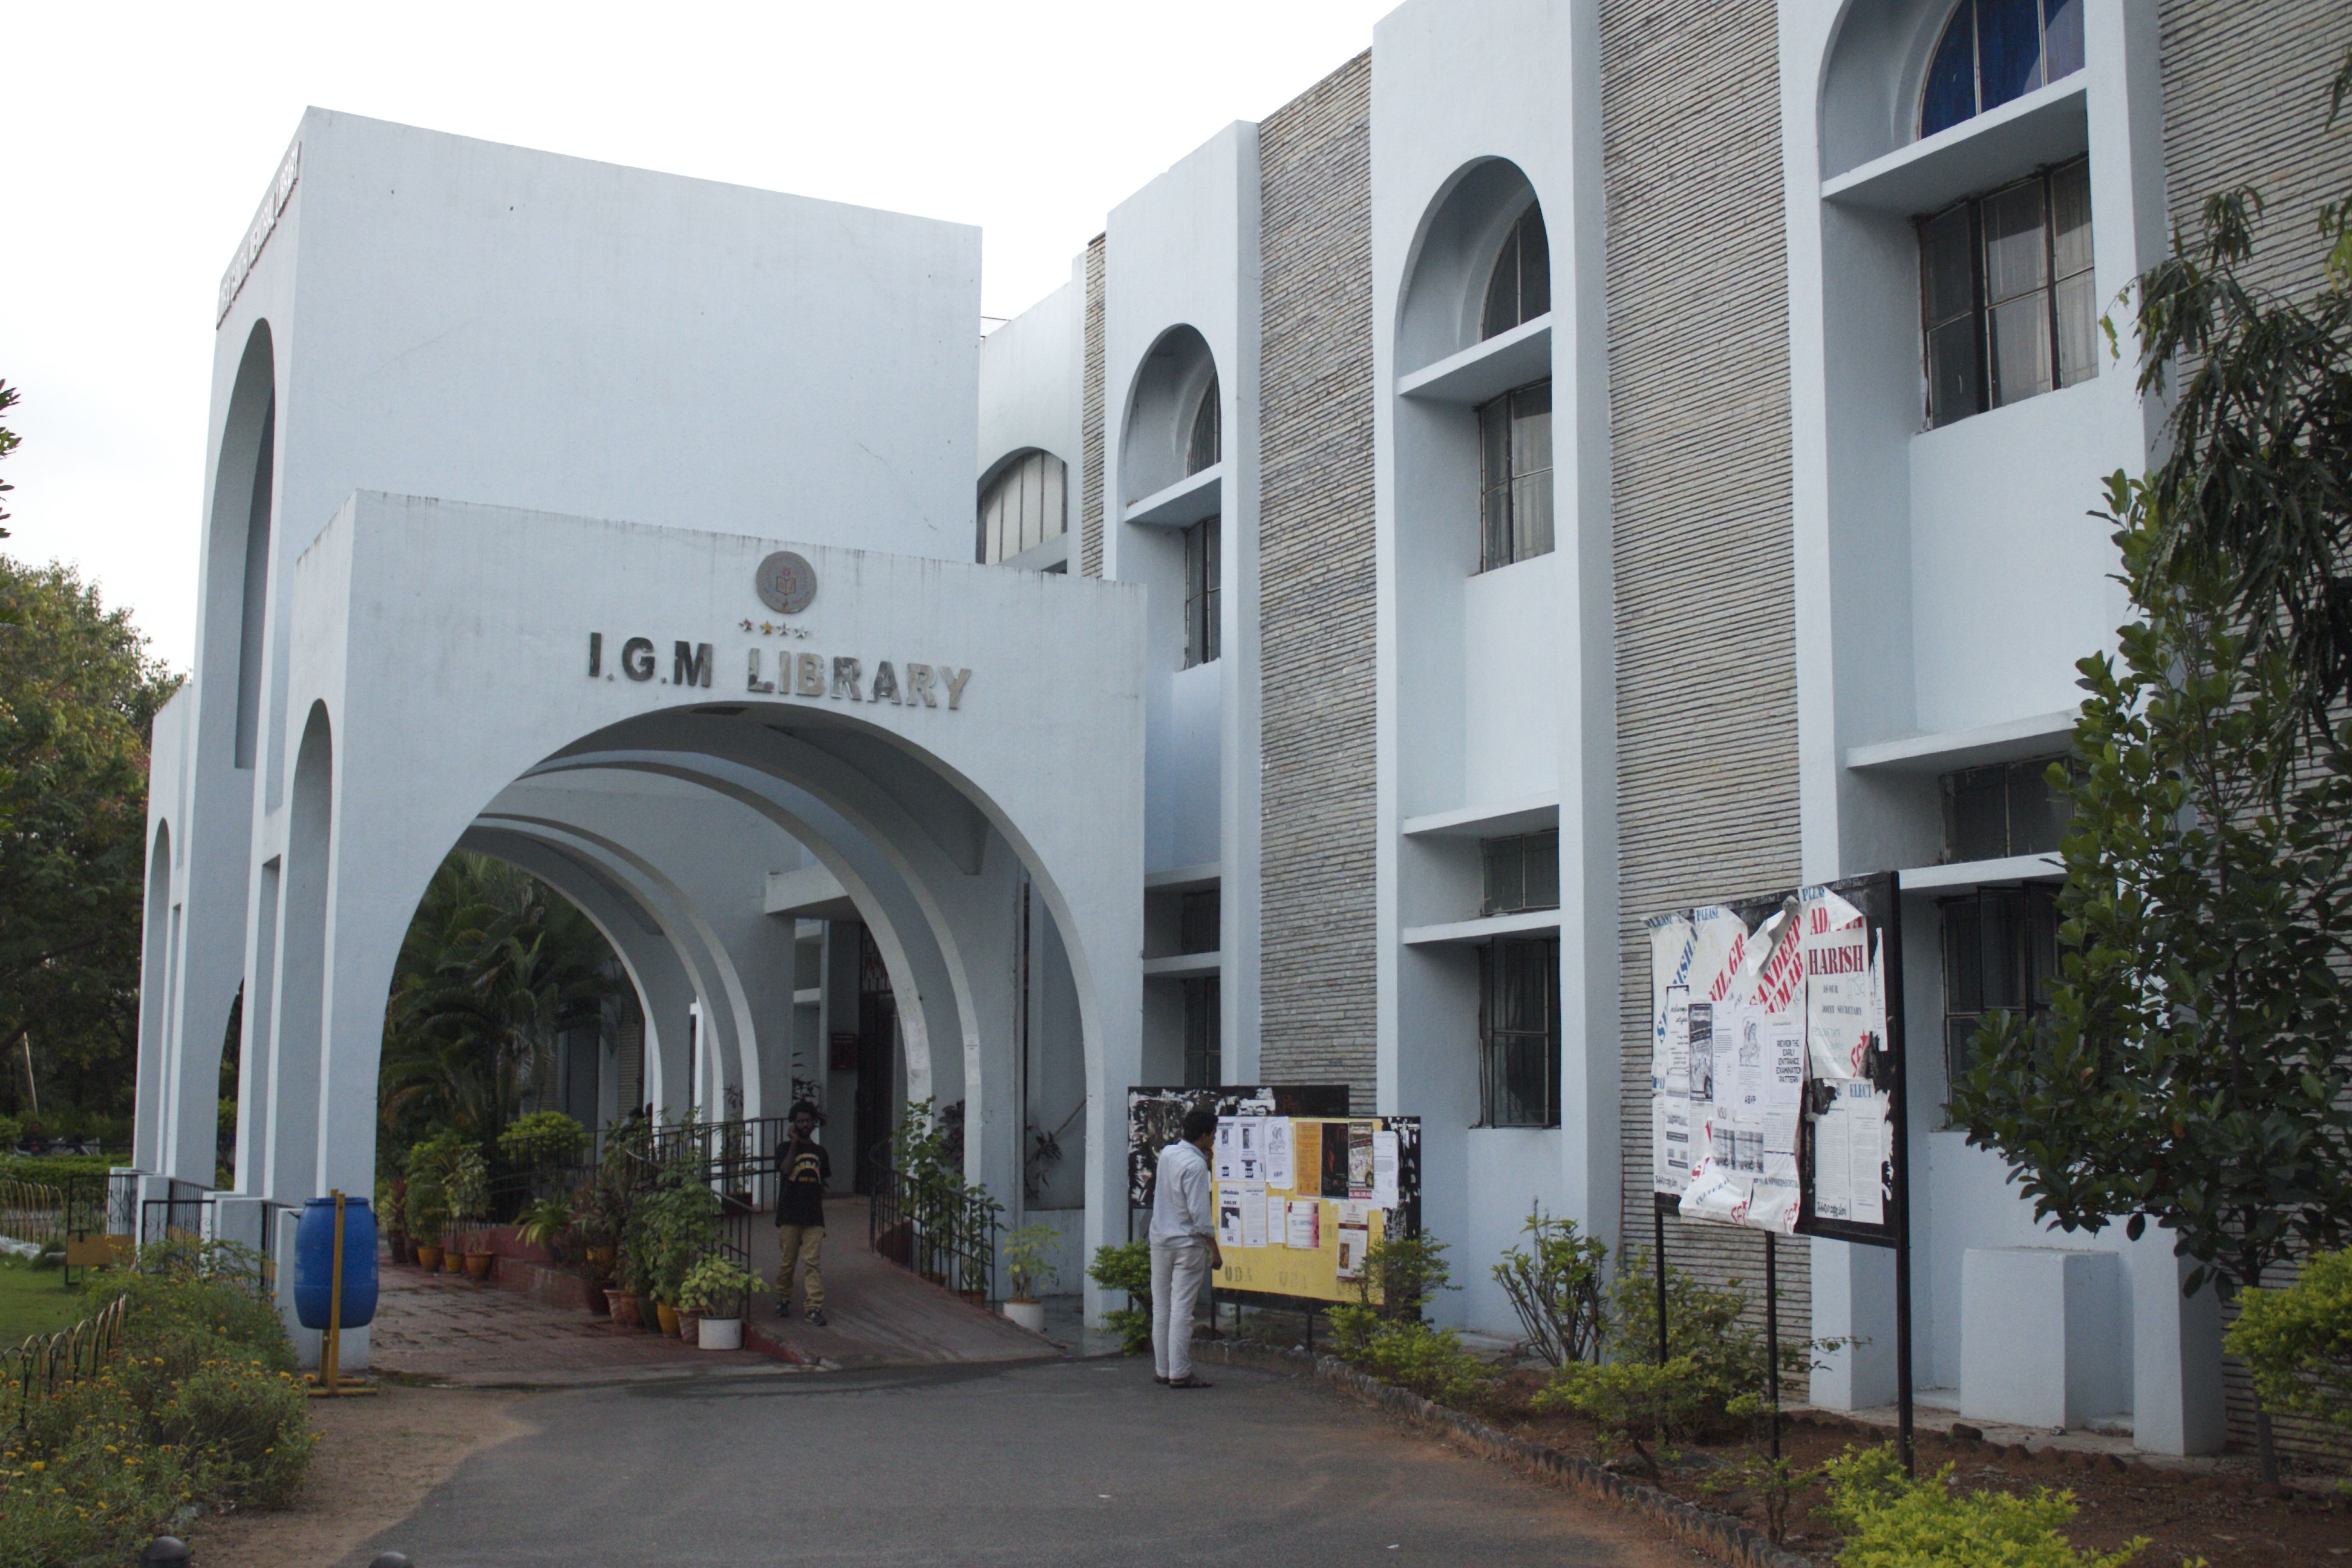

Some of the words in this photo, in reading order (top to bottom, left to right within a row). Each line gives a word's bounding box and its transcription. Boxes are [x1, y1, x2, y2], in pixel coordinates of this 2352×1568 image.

[747, 648, 972, 710] LIBRARY
[1696, 907, 1719, 921] PLEASE
[1808, 945, 1864, 975] HARISH
[1765, 952, 1803, 1014] UMAR
[1822, 1005, 1835, 1014] JOINT
[1837, 1005, 1862, 1016] SECRETARY
[1849, 1083, 1872, 1098] ELECT
